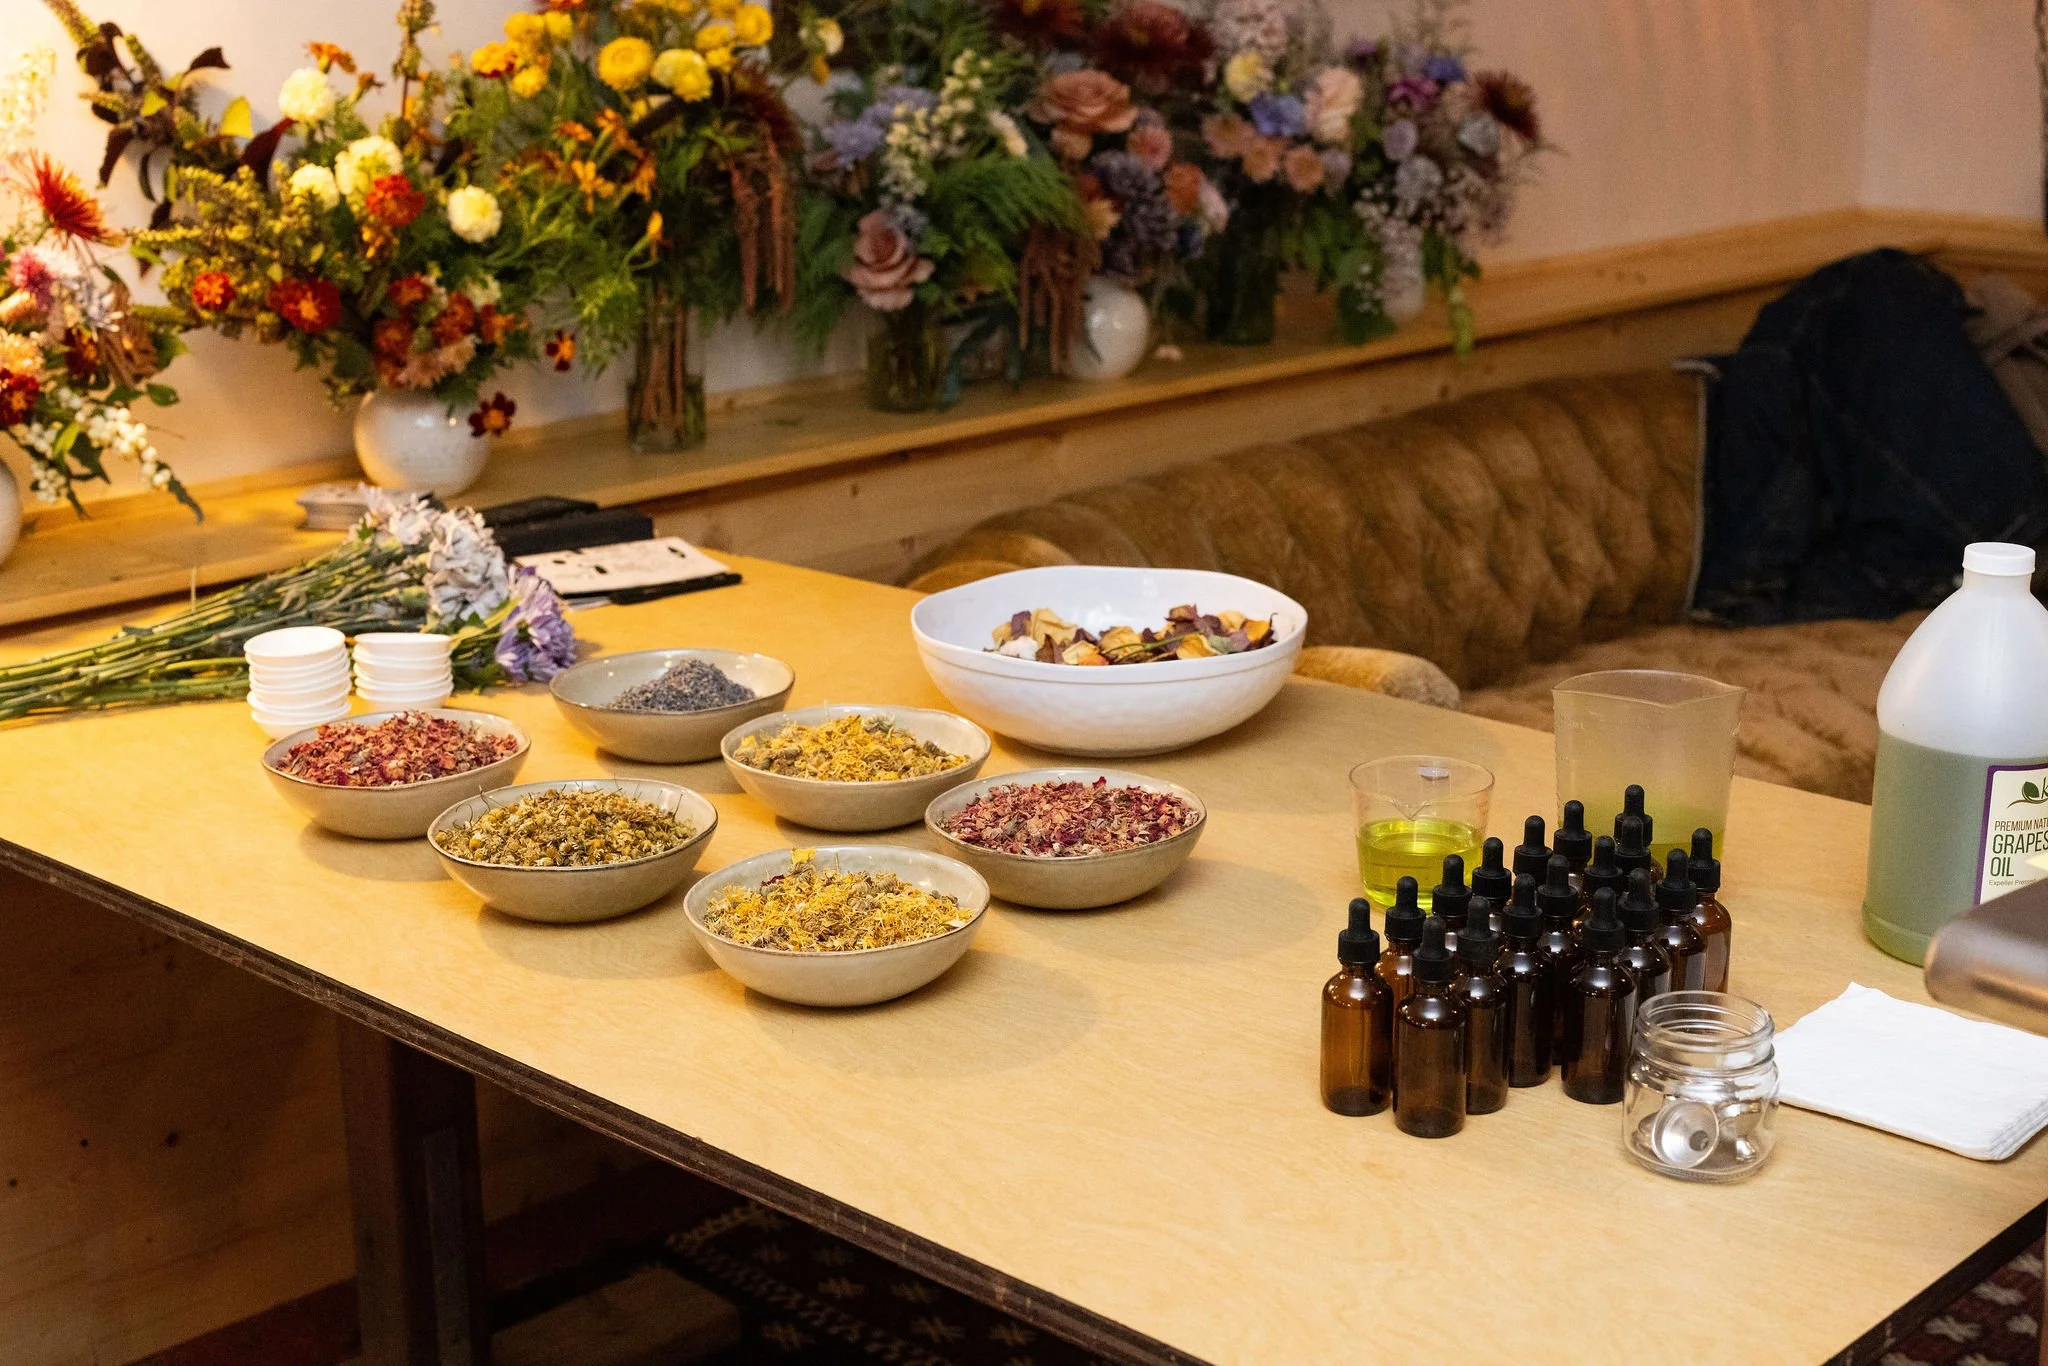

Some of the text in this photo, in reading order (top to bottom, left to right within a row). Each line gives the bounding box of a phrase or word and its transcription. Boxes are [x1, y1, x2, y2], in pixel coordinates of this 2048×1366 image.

[1995, 820, 2032, 831] PREMIUM
[1993, 830, 2048, 854] GRAPES
[1990, 857, 2014, 876] OIL
